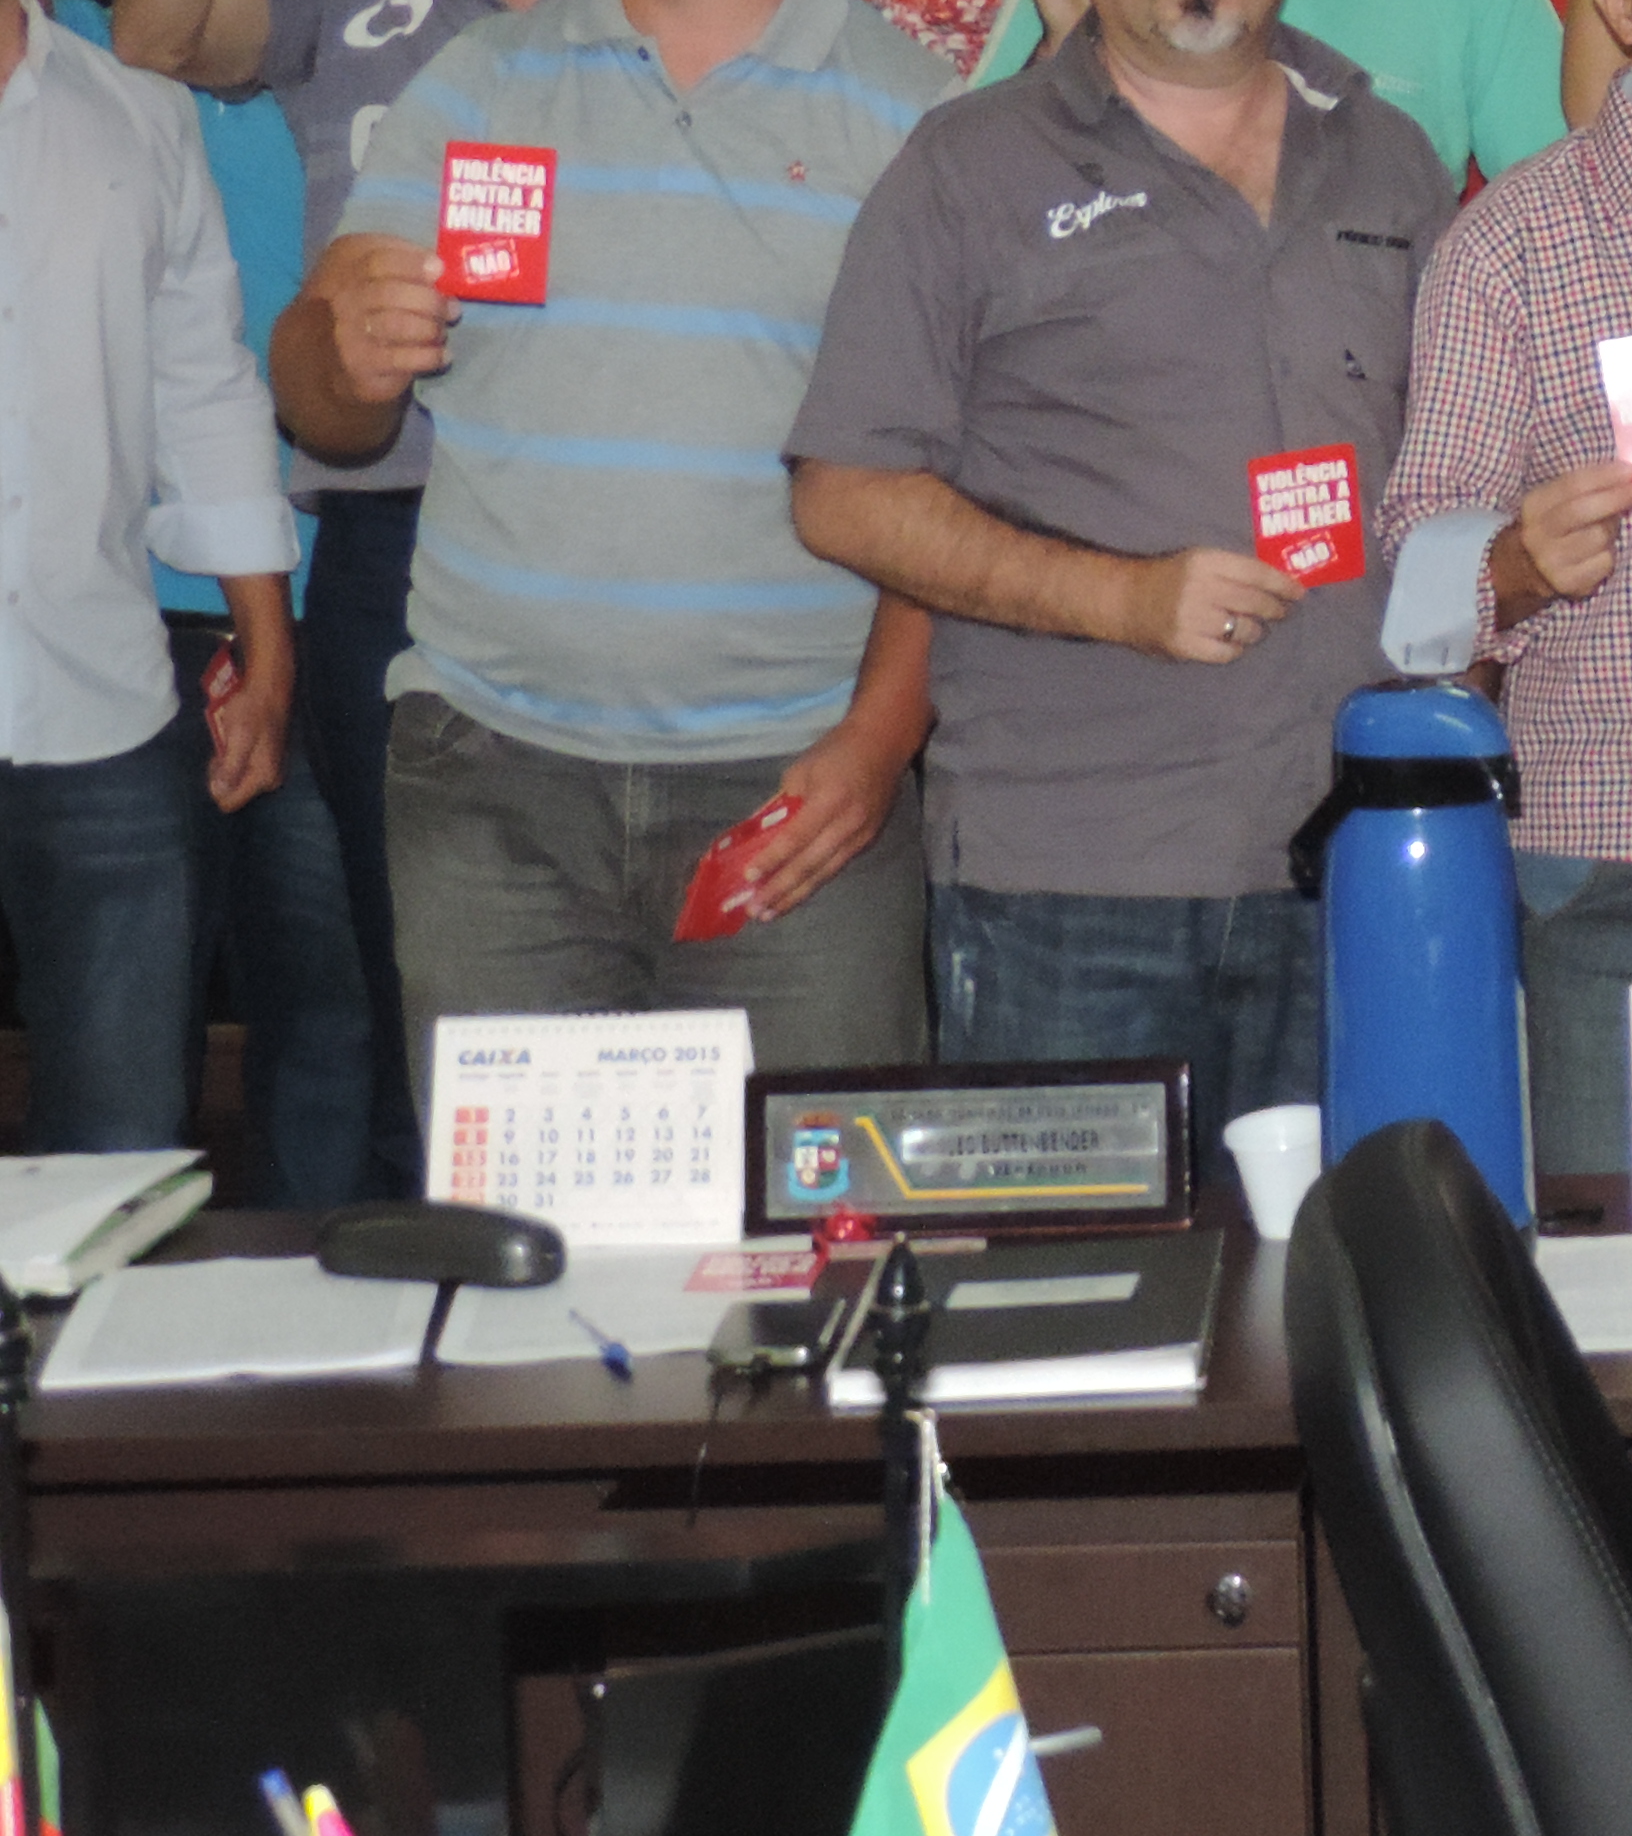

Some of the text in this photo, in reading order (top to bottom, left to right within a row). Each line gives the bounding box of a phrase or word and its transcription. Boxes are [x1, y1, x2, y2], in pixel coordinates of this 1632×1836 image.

[451, 159, 545, 187] VIOLÊNCIA
[448, 181, 543, 209] CONTRA A
[446, 203, 540, 235] MULHER
[468, 248, 510, 276] NÃO
[1257, 461, 1347, 492] VIOLÊNCIA
[1259, 478, 1349, 512] CONTRA A
[1261, 498, 1350, 536] MULHER
[1290, 542, 1329, 569] NÃO
[458, 1048, 531, 1065] CAIXA
[598, 1046, 721, 1066] MARÇO 2015
